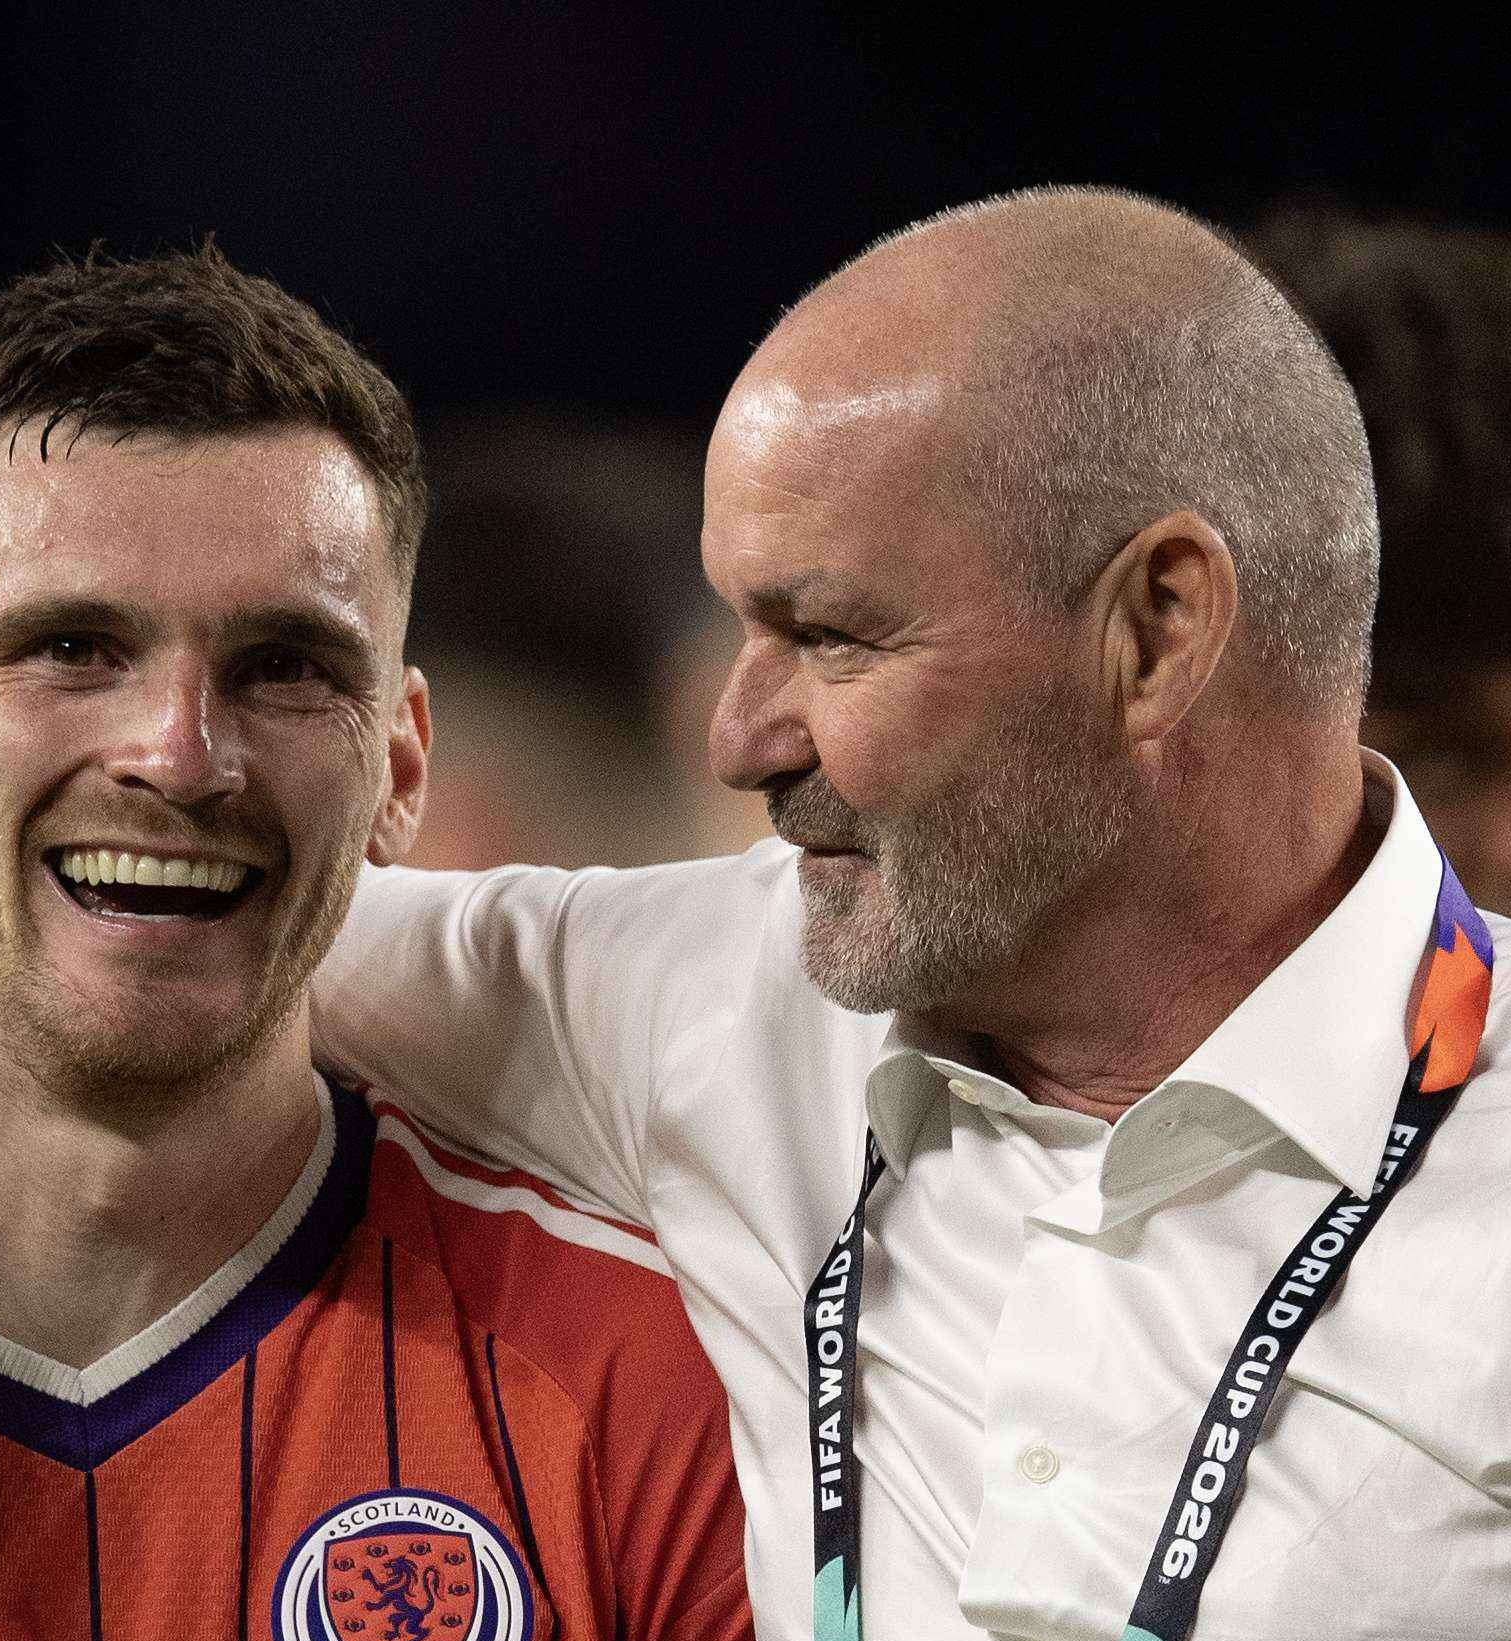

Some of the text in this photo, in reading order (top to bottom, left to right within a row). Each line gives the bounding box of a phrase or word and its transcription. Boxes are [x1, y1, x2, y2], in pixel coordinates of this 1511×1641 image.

[1266, 1204, 1370, 1329] WORLD
[815, 1250, 852, 1408] WORLD
[1226, 1335, 1280, 1419] CUP
[818, 1410, 843, 1511] FIFA
[1162, 1422, 1240, 1580] 2026
[338, 1502, 455, 1534] SCOTLAND
